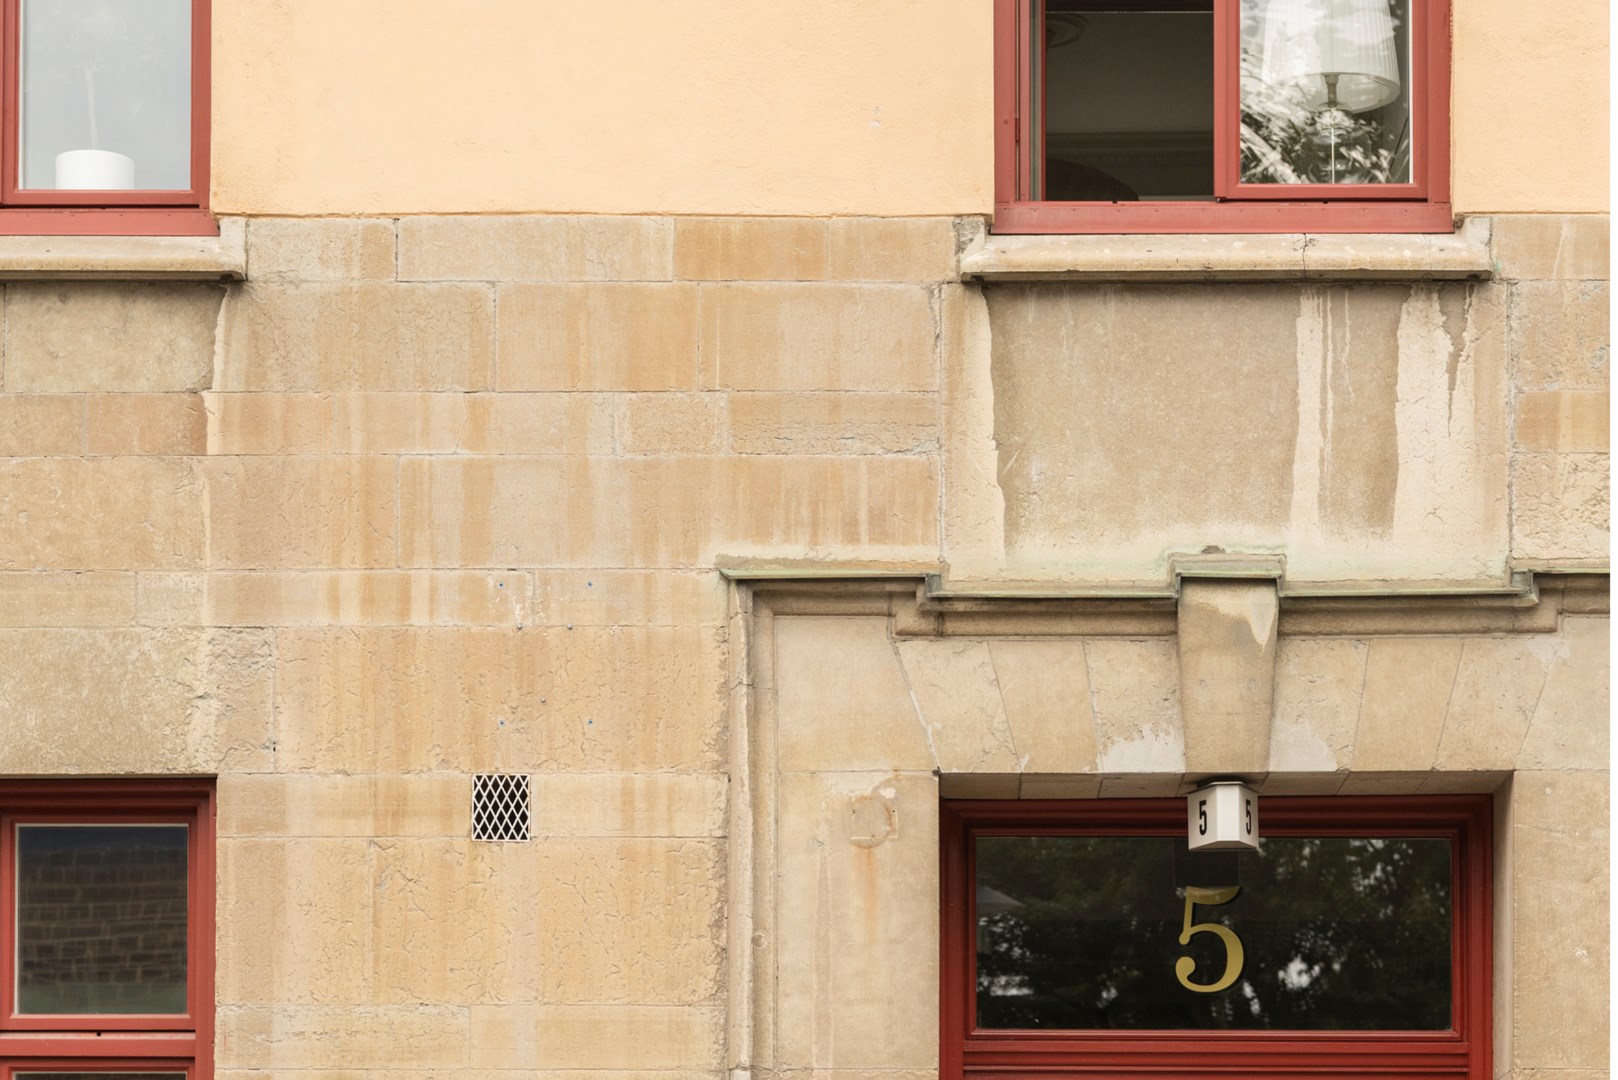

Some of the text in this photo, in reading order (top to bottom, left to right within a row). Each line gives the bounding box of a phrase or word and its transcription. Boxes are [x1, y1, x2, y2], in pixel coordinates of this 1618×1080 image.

[1198, 799, 1208, 836] 5
[1245, 799, 1252, 836] 5
[1174, 885, 1245, 993] 5
